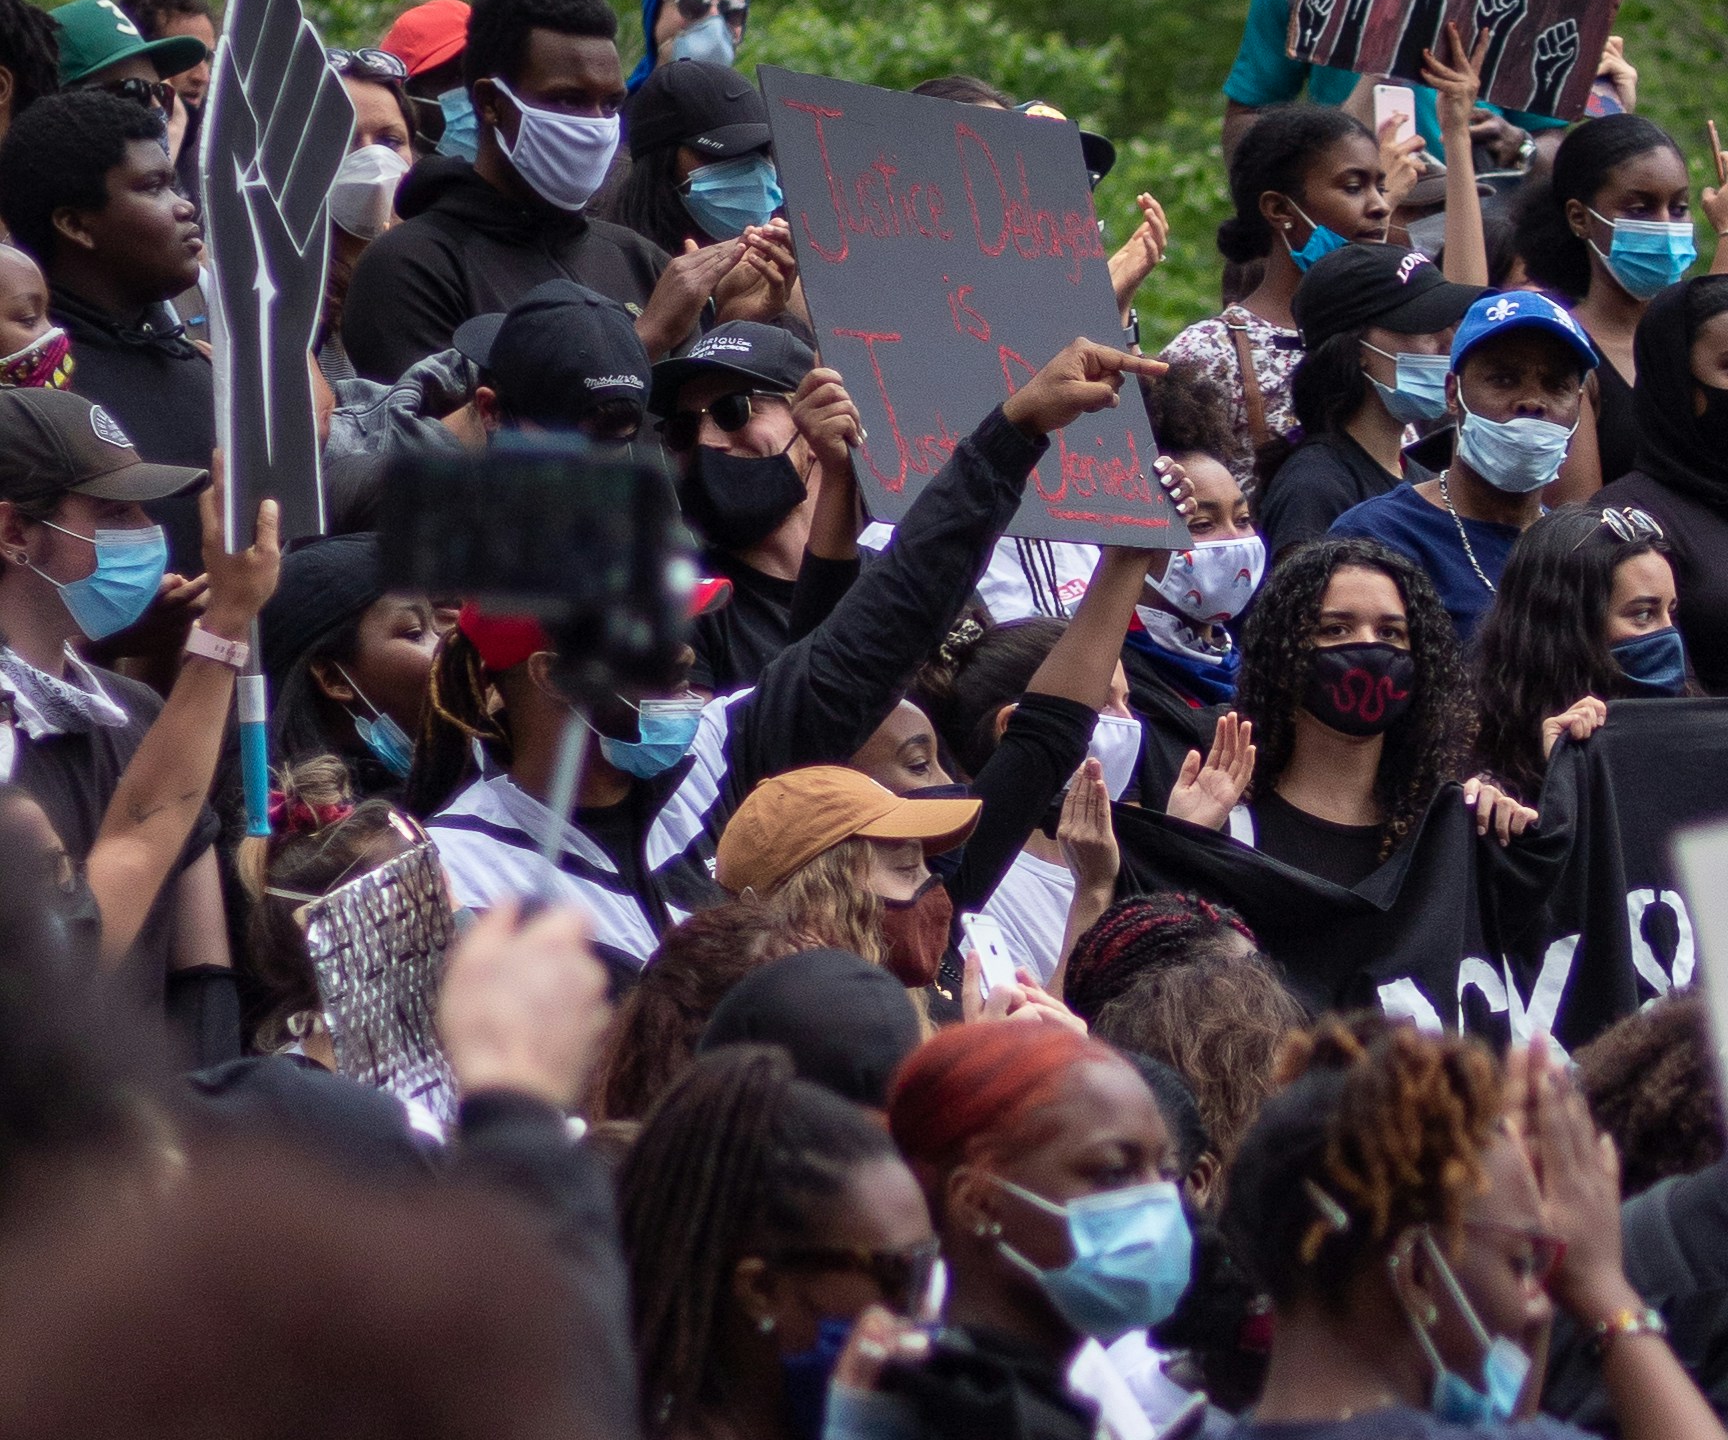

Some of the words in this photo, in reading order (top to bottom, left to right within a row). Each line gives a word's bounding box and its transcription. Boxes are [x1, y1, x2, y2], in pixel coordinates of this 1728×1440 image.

[783, 98, 954, 263] Justice
[955, 122, 1106, 286] Delayed
[943, 274, 991, 342] is
